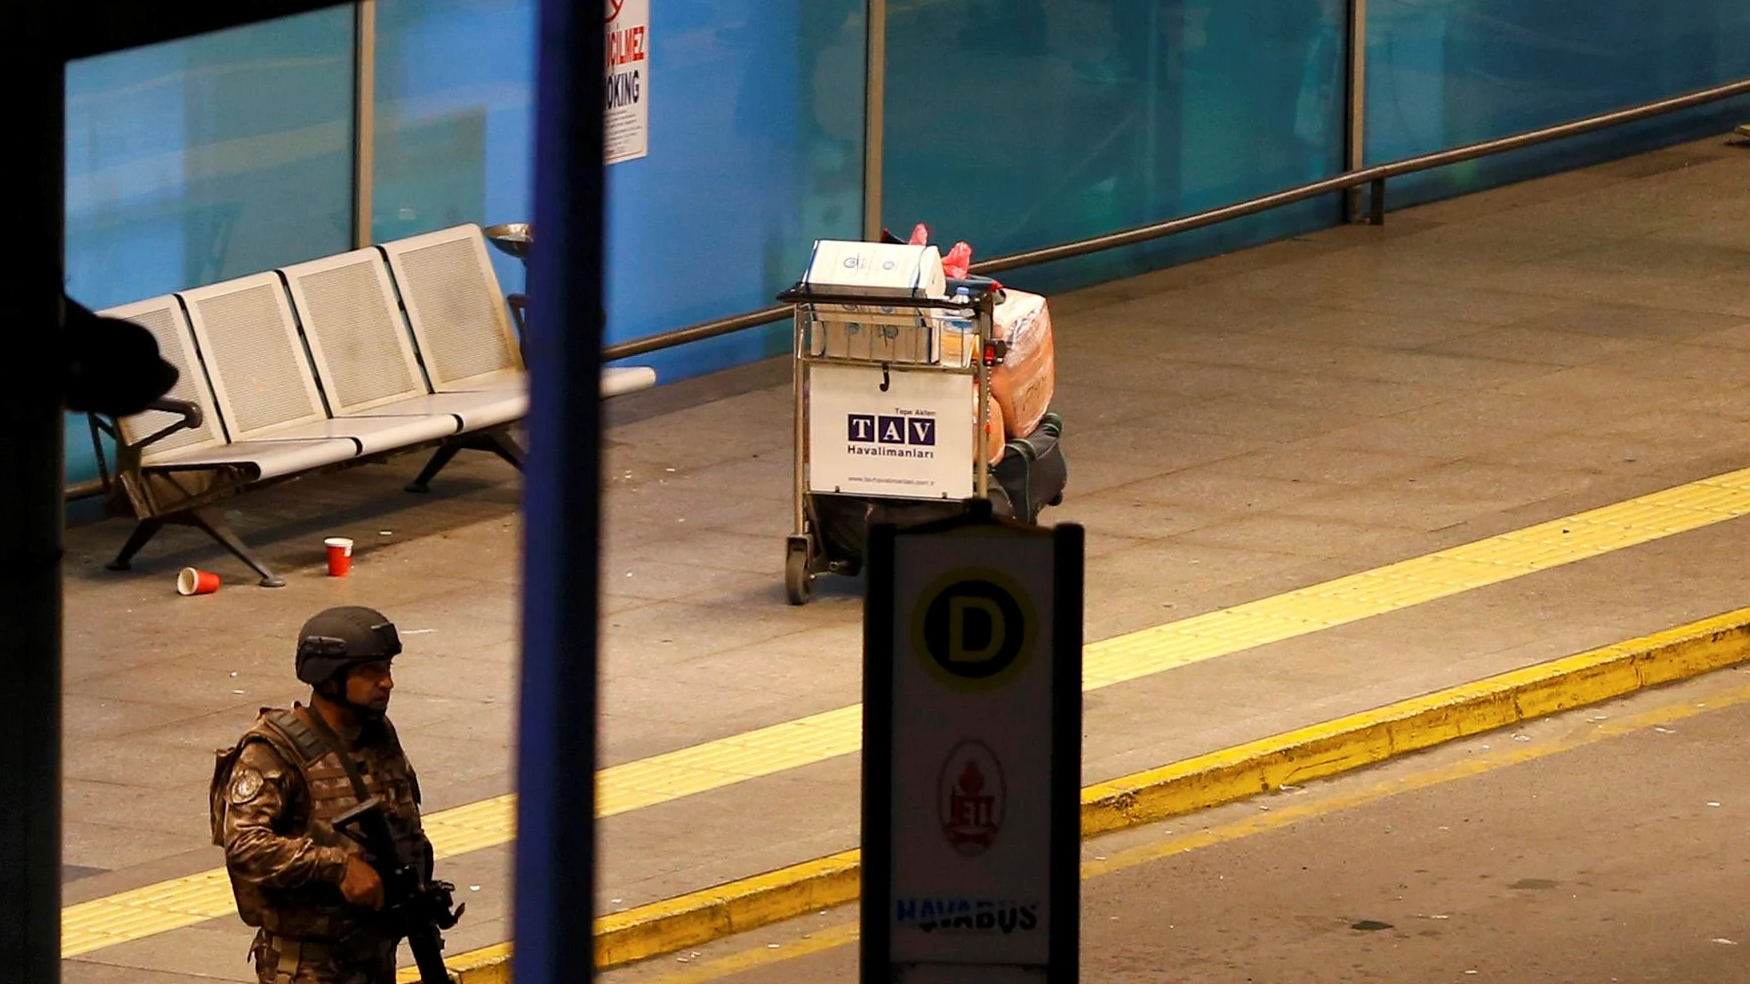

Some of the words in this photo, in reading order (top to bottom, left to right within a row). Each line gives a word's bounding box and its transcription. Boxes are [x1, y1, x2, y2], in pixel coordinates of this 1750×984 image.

[606, 70, 640, 110] OKING
[851, 417, 932, 443] TAV
[847, 445, 934, 458] Havalimanları
[949, 597, 1006, 663] D
